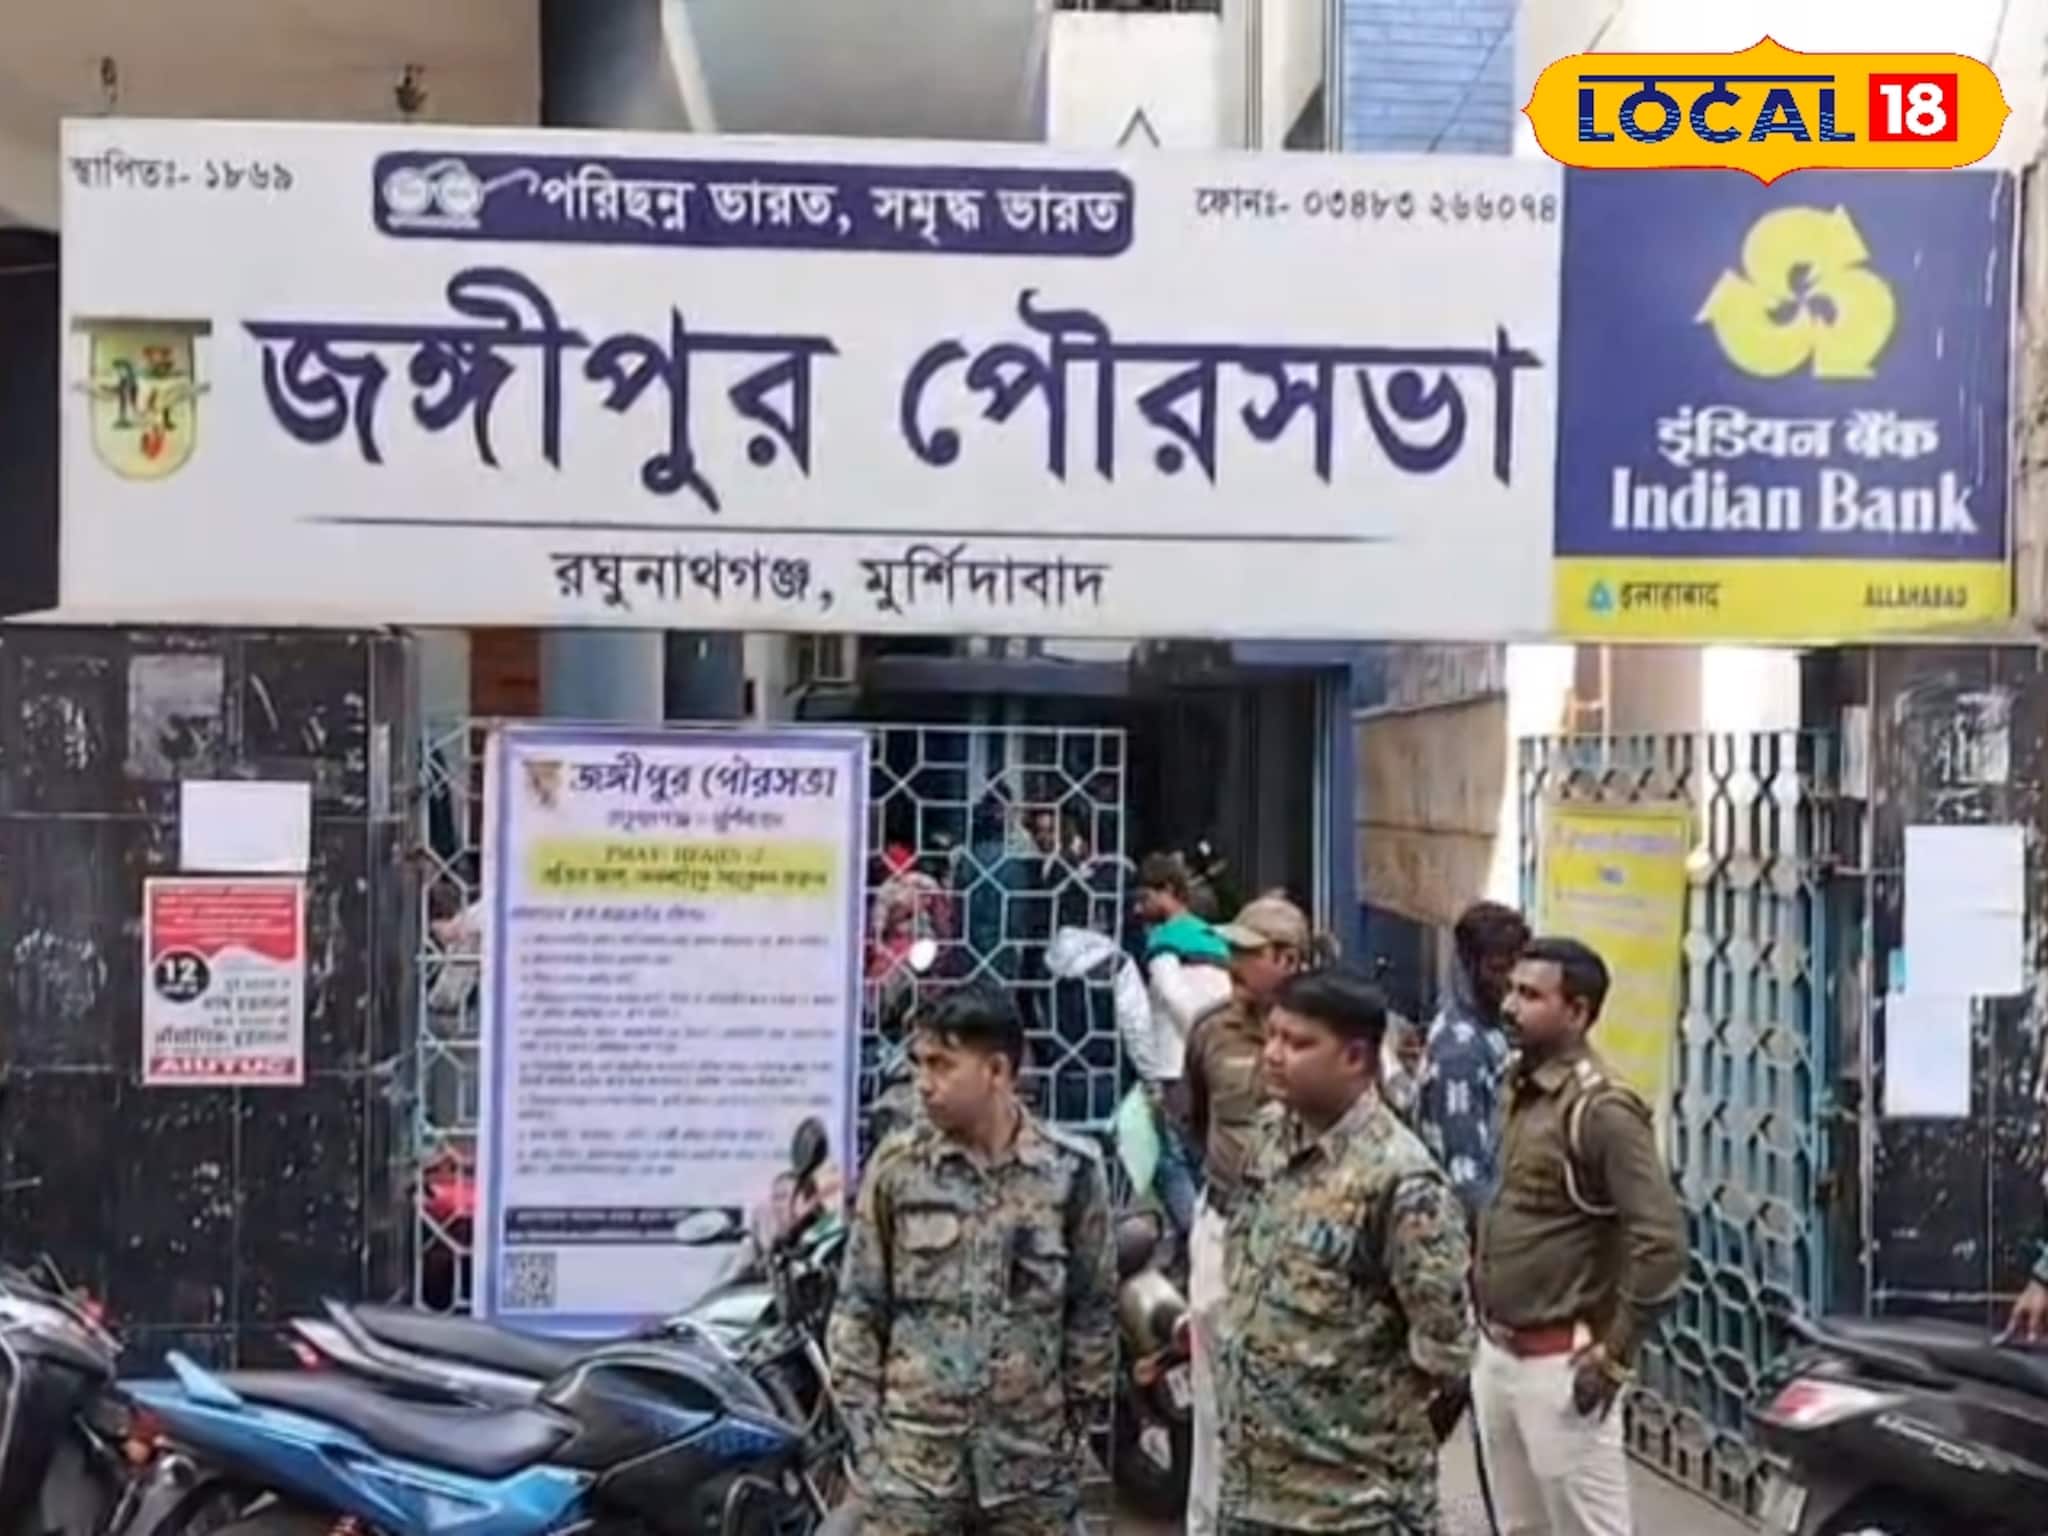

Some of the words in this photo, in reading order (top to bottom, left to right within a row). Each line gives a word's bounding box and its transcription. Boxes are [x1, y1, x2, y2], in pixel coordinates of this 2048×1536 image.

[205, 159, 293, 191] ১৮৬৯
[1303, 189, 1416, 220] ০৩৪৮৩
[1429, 191, 1557, 224] ২৬৬০৭৪
[705, 180, 852, 235] ভারত,
[869, 186, 985, 245] সমৃদ্ধ
[996, 184, 1127, 234] ভারত
[242, 266, 838, 513] জঙ্গীপুর
[900, 288, 1544, 487] পৌরসভা
[1657, 405, 1831, 467] इंडियन
[1844, 406, 1940, 460] बैंक
[1612, 467, 1800, 532] Indian
[1819, 469, 1979, 535] Bank
[550, 550, 834, 612] রঘুনাথগঞ্জ,
[859, 546, 1111, 613] মুর্শিদাবাদ
[166, 957, 197, 983] 12
